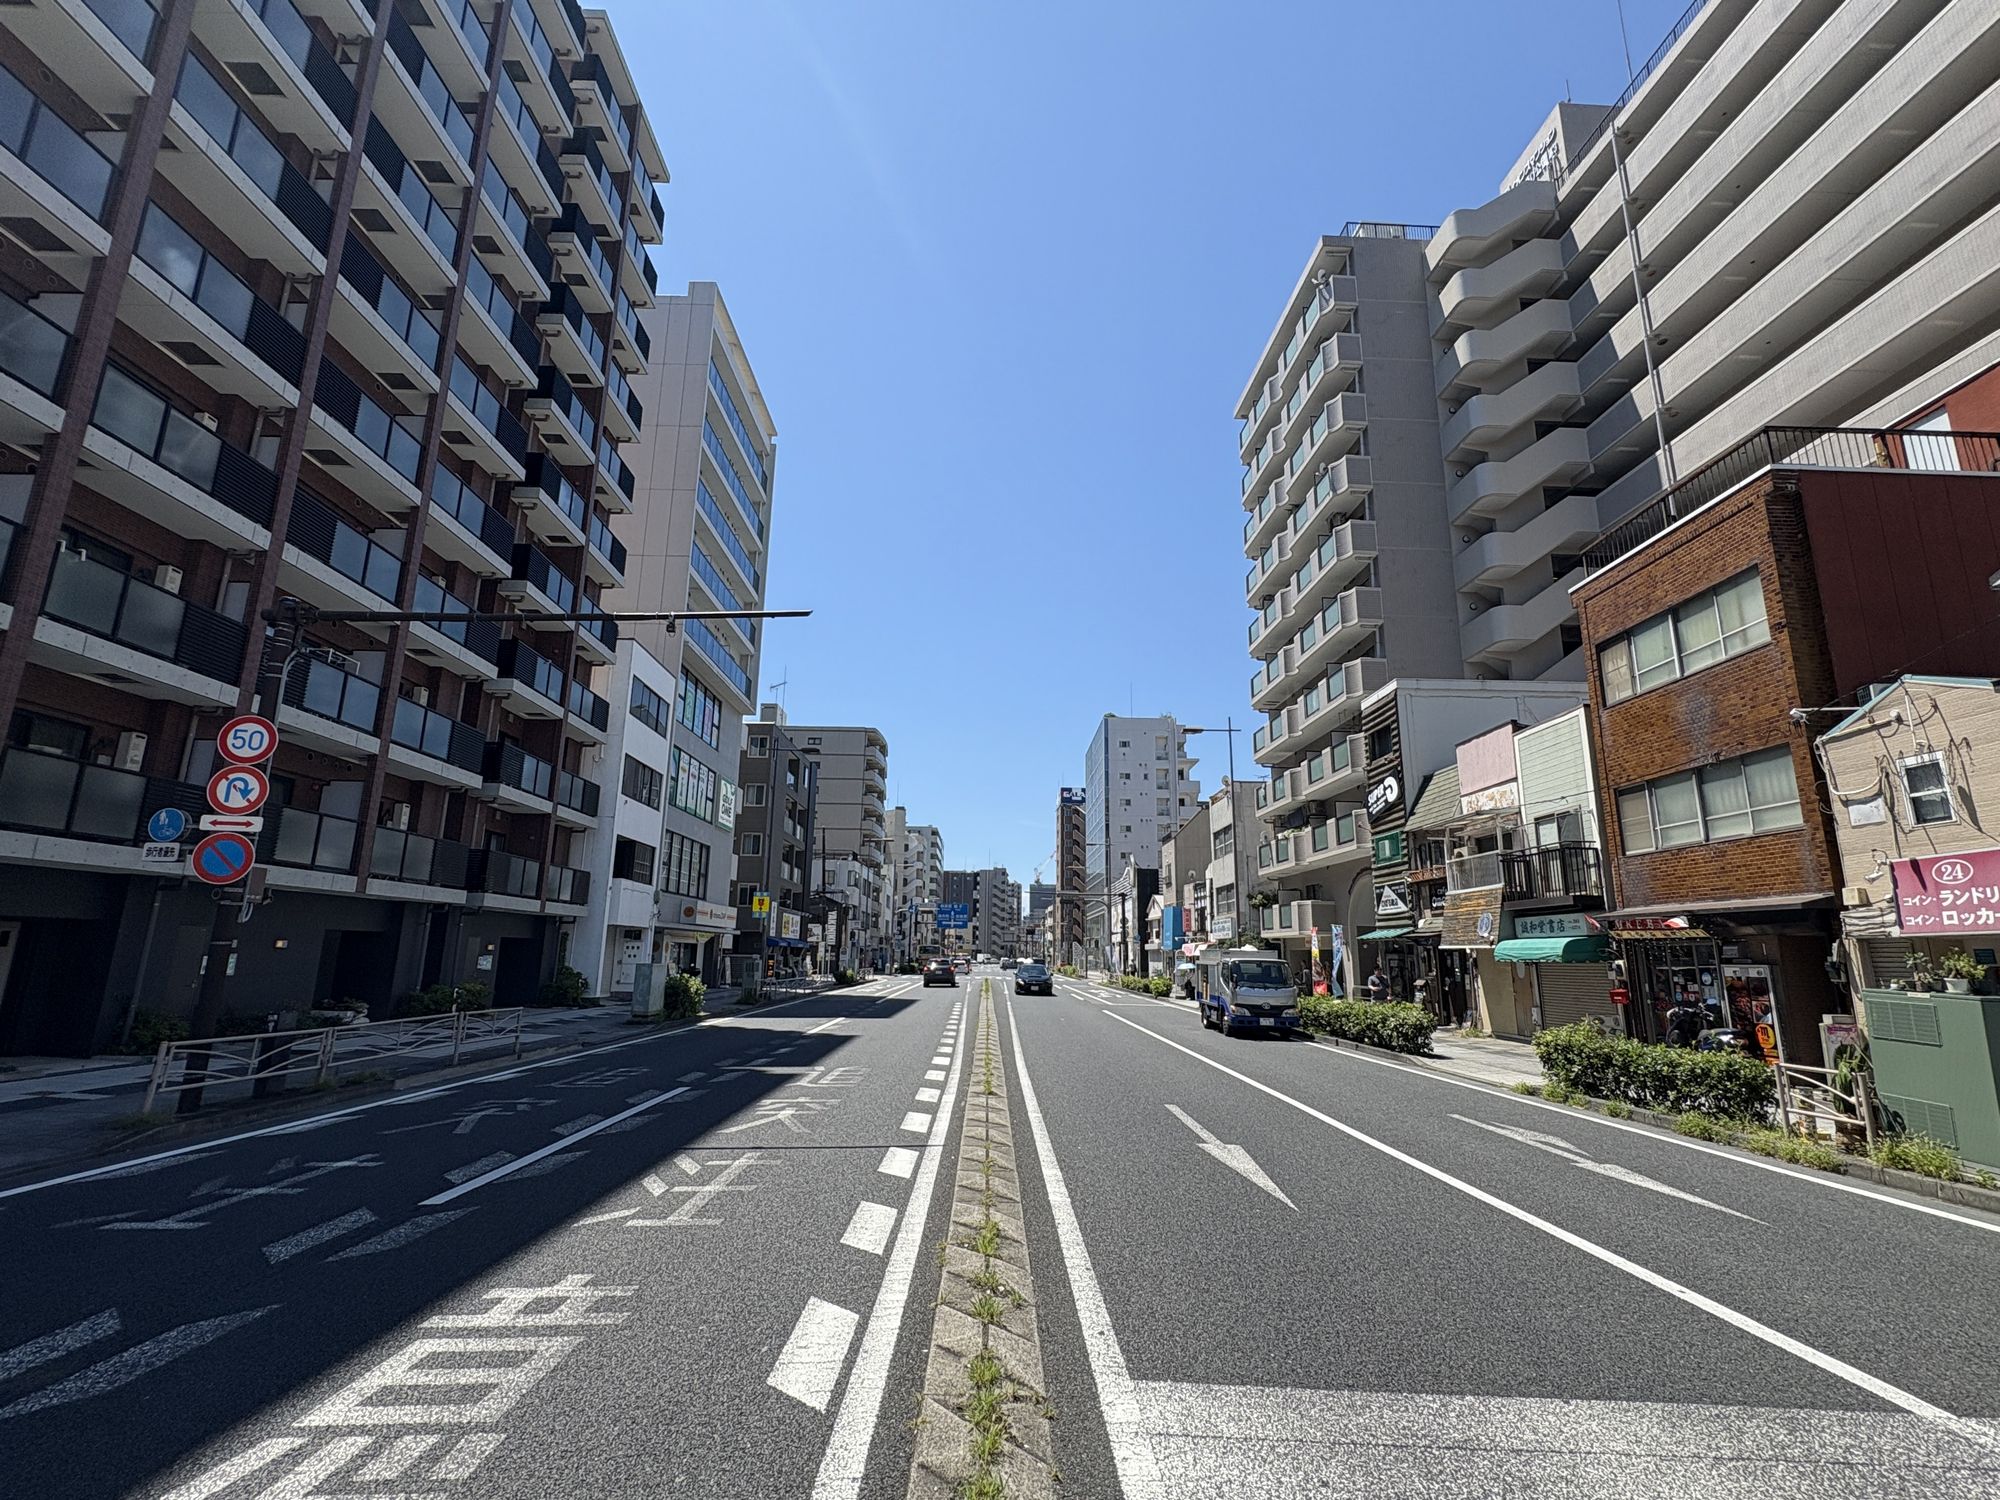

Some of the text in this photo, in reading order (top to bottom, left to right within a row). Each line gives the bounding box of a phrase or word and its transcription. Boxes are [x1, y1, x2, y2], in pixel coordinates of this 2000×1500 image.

[231, 729, 265, 751] 50
[721, 804, 732, 818] ONE
[1941, 863, 1964, 881] 24
